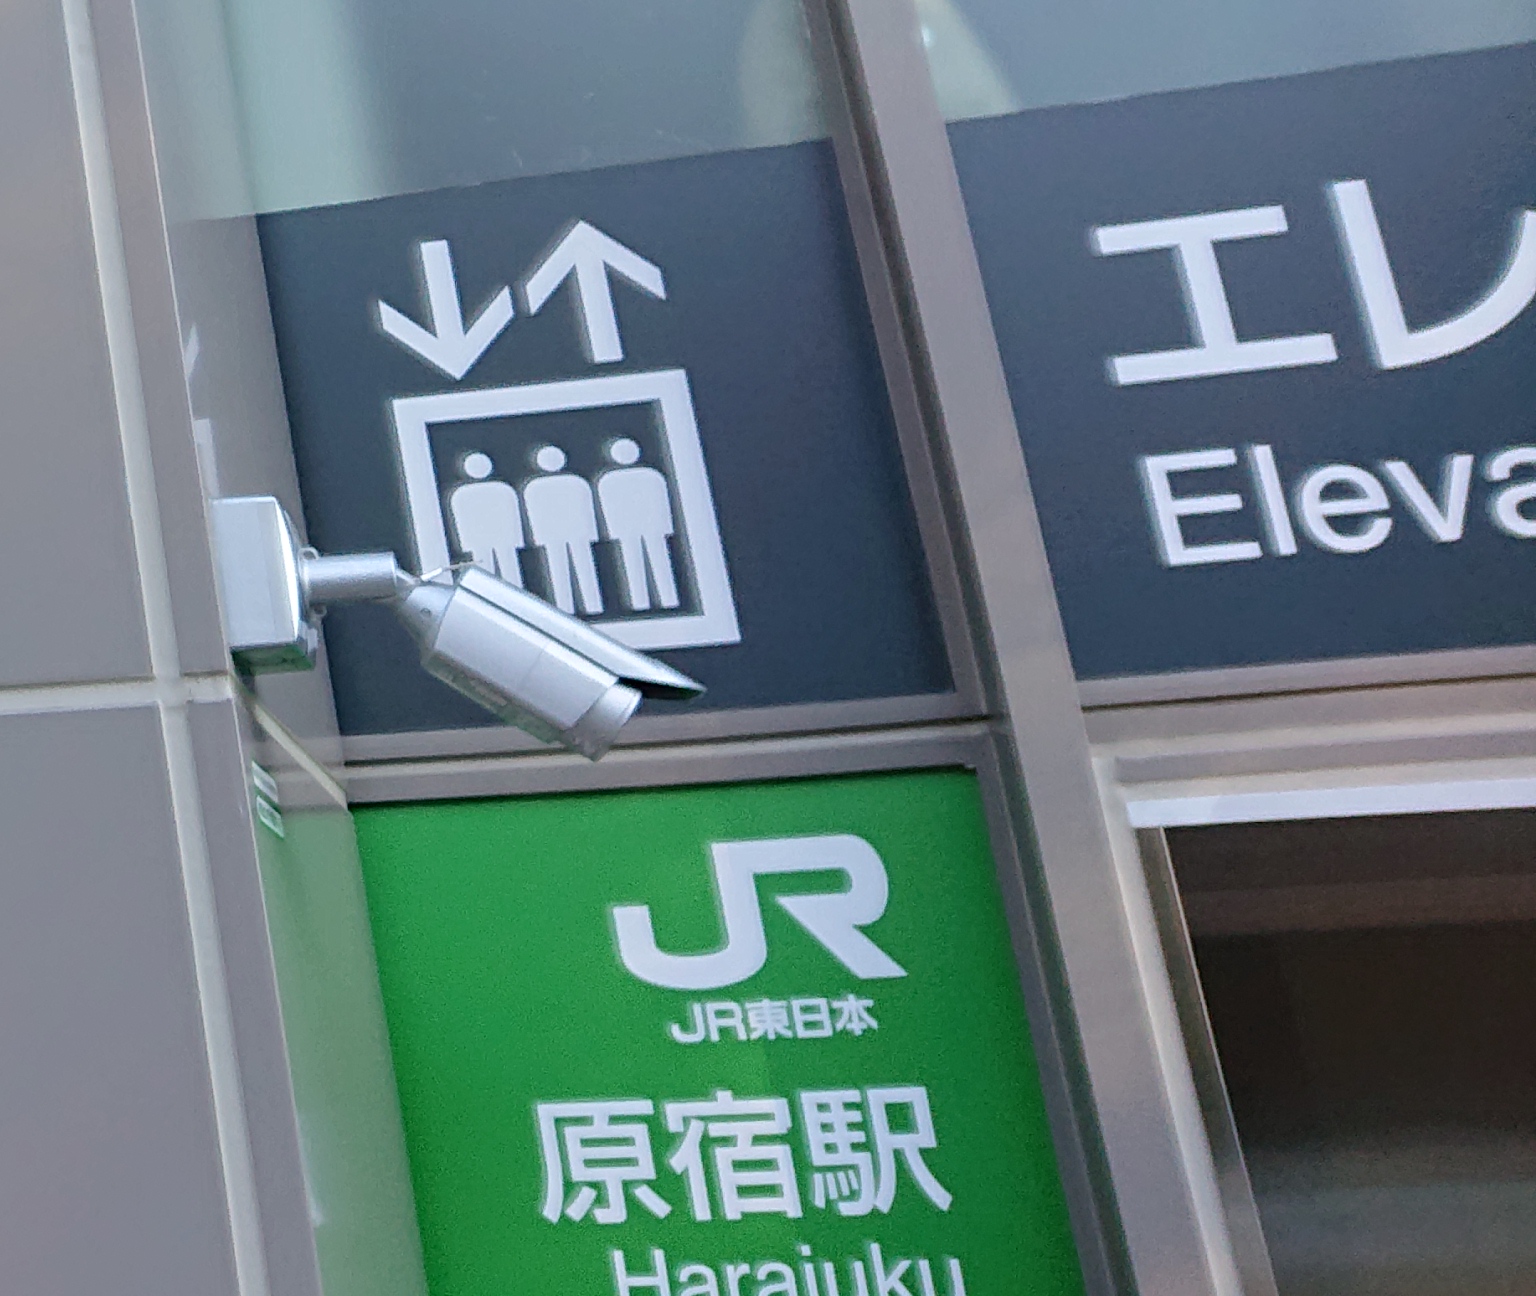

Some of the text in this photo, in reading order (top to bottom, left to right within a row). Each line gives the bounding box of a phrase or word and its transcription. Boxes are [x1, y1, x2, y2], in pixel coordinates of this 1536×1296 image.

[1088, 178, 1536, 388] エレ
[611, 833, 909, 990] JR
[669, 994, 880, 1044] JR東日本
[535, 1085, 954, 1225] 原宿駅
[610, 1240, 968, 1296] Harajuku
